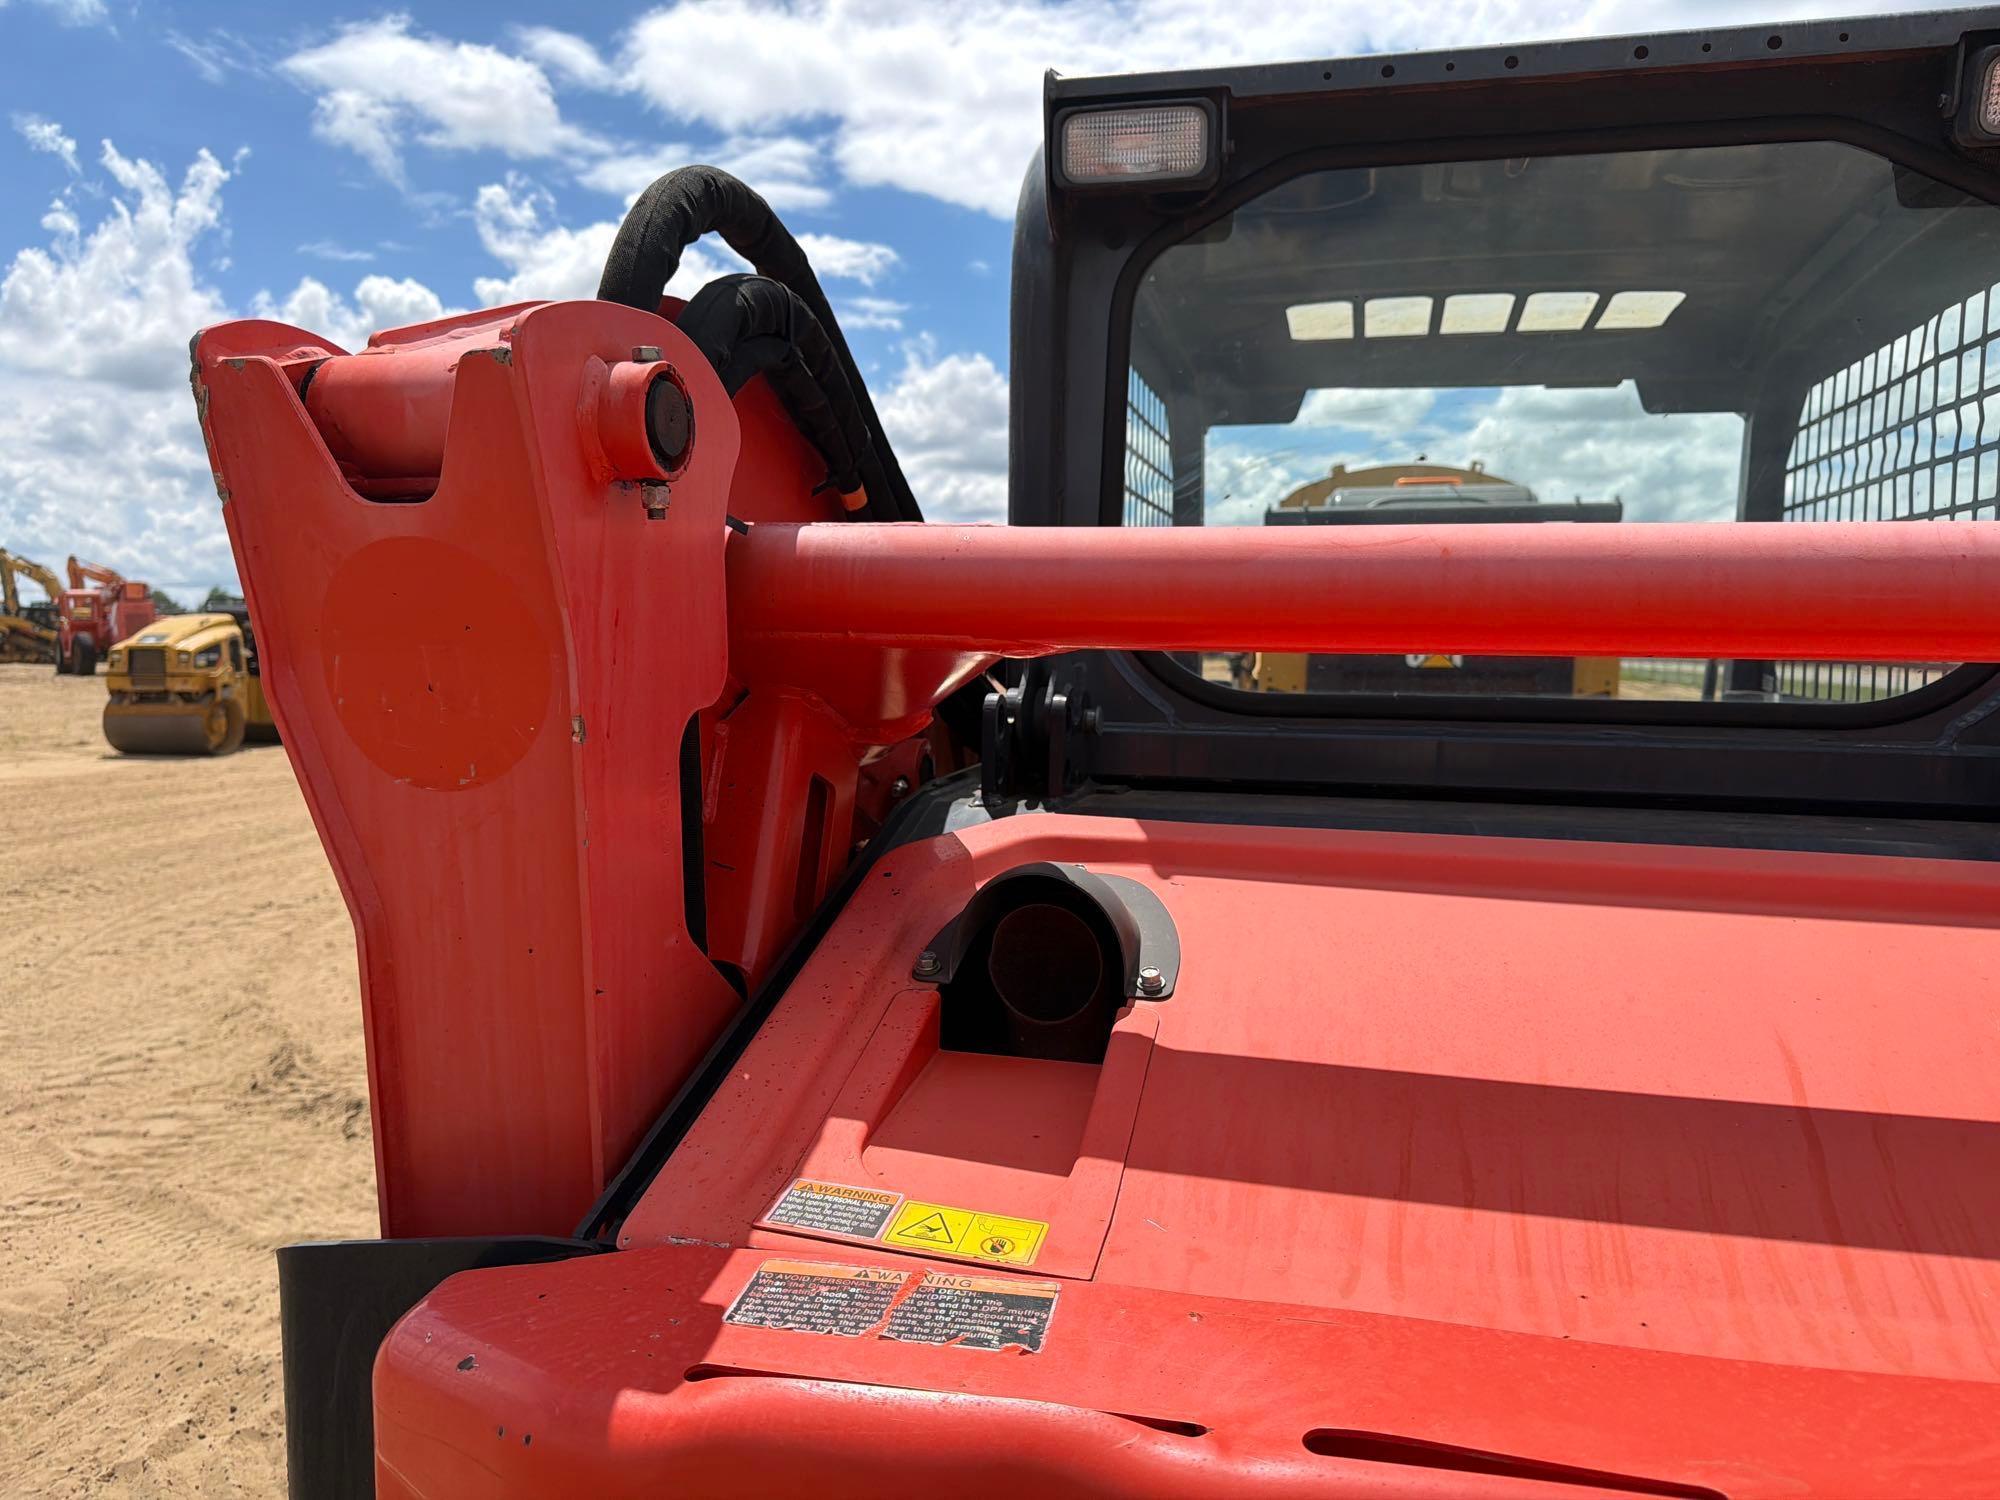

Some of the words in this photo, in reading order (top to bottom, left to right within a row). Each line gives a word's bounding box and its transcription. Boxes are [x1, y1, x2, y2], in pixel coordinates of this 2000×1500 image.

[800, 1191, 824, 1200] AVOID
[824, 1194, 861, 1206] PERSONAL
[818, 1185, 891, 1203] WARNING
[780, 1203, 803, 1211] engine
[832, 1211, 857, 1219] careful
[803, 1212, 824, 1221] hands
[805, 1200, 832, 1209] opening
[845, 1206, 870, 1215] closing
[870, 1209, 881, 1217] the
[812, 1221, 830, 1230] body
[775, 1274, 811, 1282] AVOID
[812, 1277, 872, 1288] PERSONAL
[878, 1271, 972, 1288] WANING
[758, 1279, 787, 1287] When
[787, 1281, 805, 1289] the
[986, 1299, 1003, 1307] the
[748, 1290, 789, 1300] become
[814, 1296, 849, 1307] During
[971, 1312, 1014, 1320] account
[981, 1305, 1006, 1313] DPF
[763, 1300, 801, 1308] muffler
[838, 1306, 861, 1315] very
[905, 1312, 932, 1320] keep
[954, 1317, 1000, 1327] machine
[810, 1317, 836, 1325] keep
[933, 1327, 958, 1336] DPF
[946, 1323, 1002, 1333] flammable
